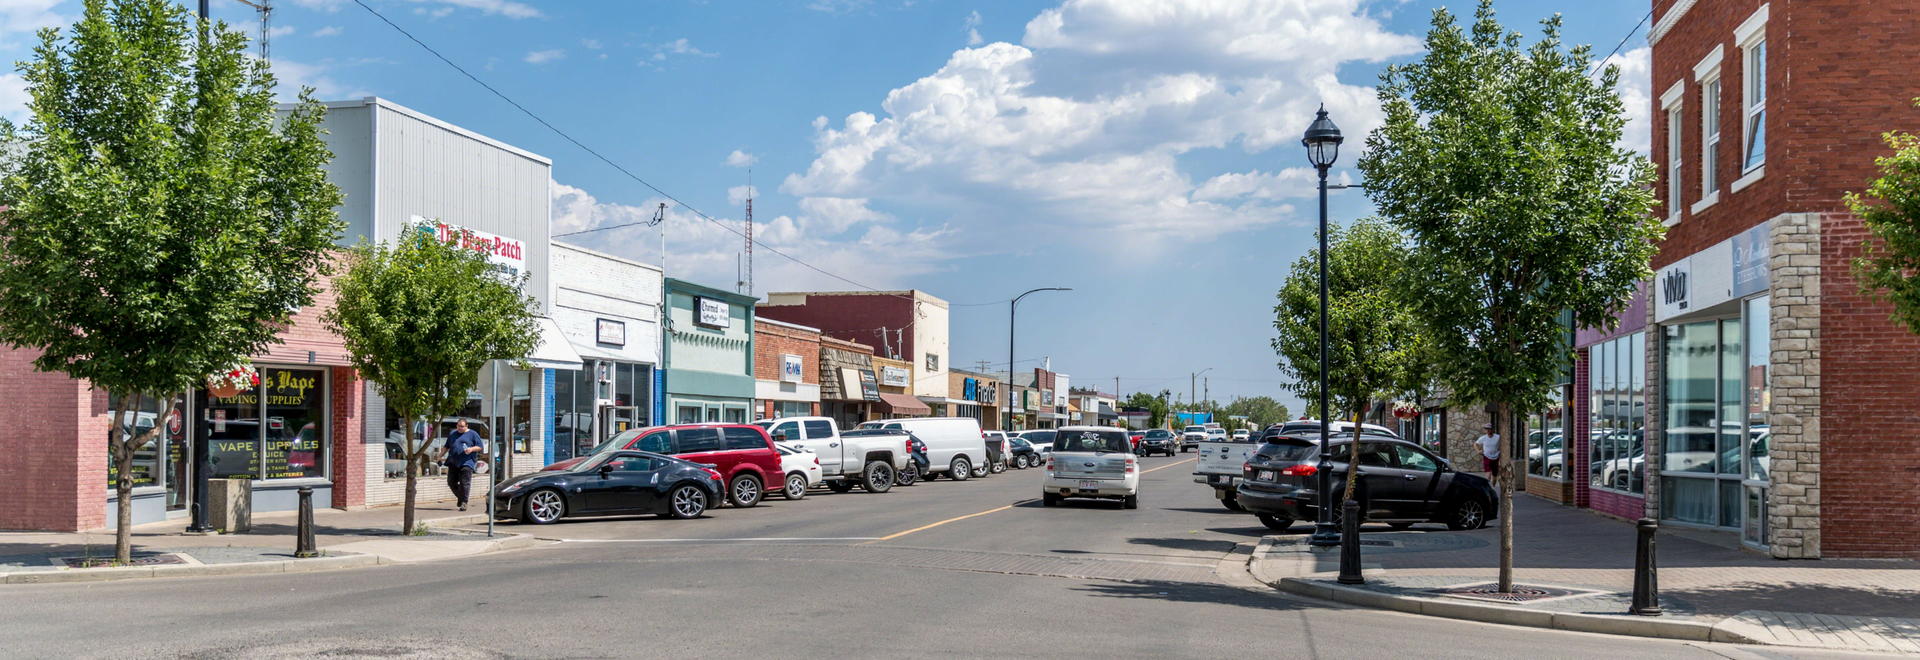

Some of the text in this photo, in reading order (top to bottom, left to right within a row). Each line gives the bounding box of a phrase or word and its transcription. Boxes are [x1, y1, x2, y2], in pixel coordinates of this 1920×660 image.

[494, 236, 522, 261] Patch
[277, 371, 316, 400] Vape
[965, 377, 976, 401] ATB
[977, 379, 996, 404] Financial
[266, 395, 303, 406] UPPLIES
[219, 440, 319, 452] VAPE UPPLIES
